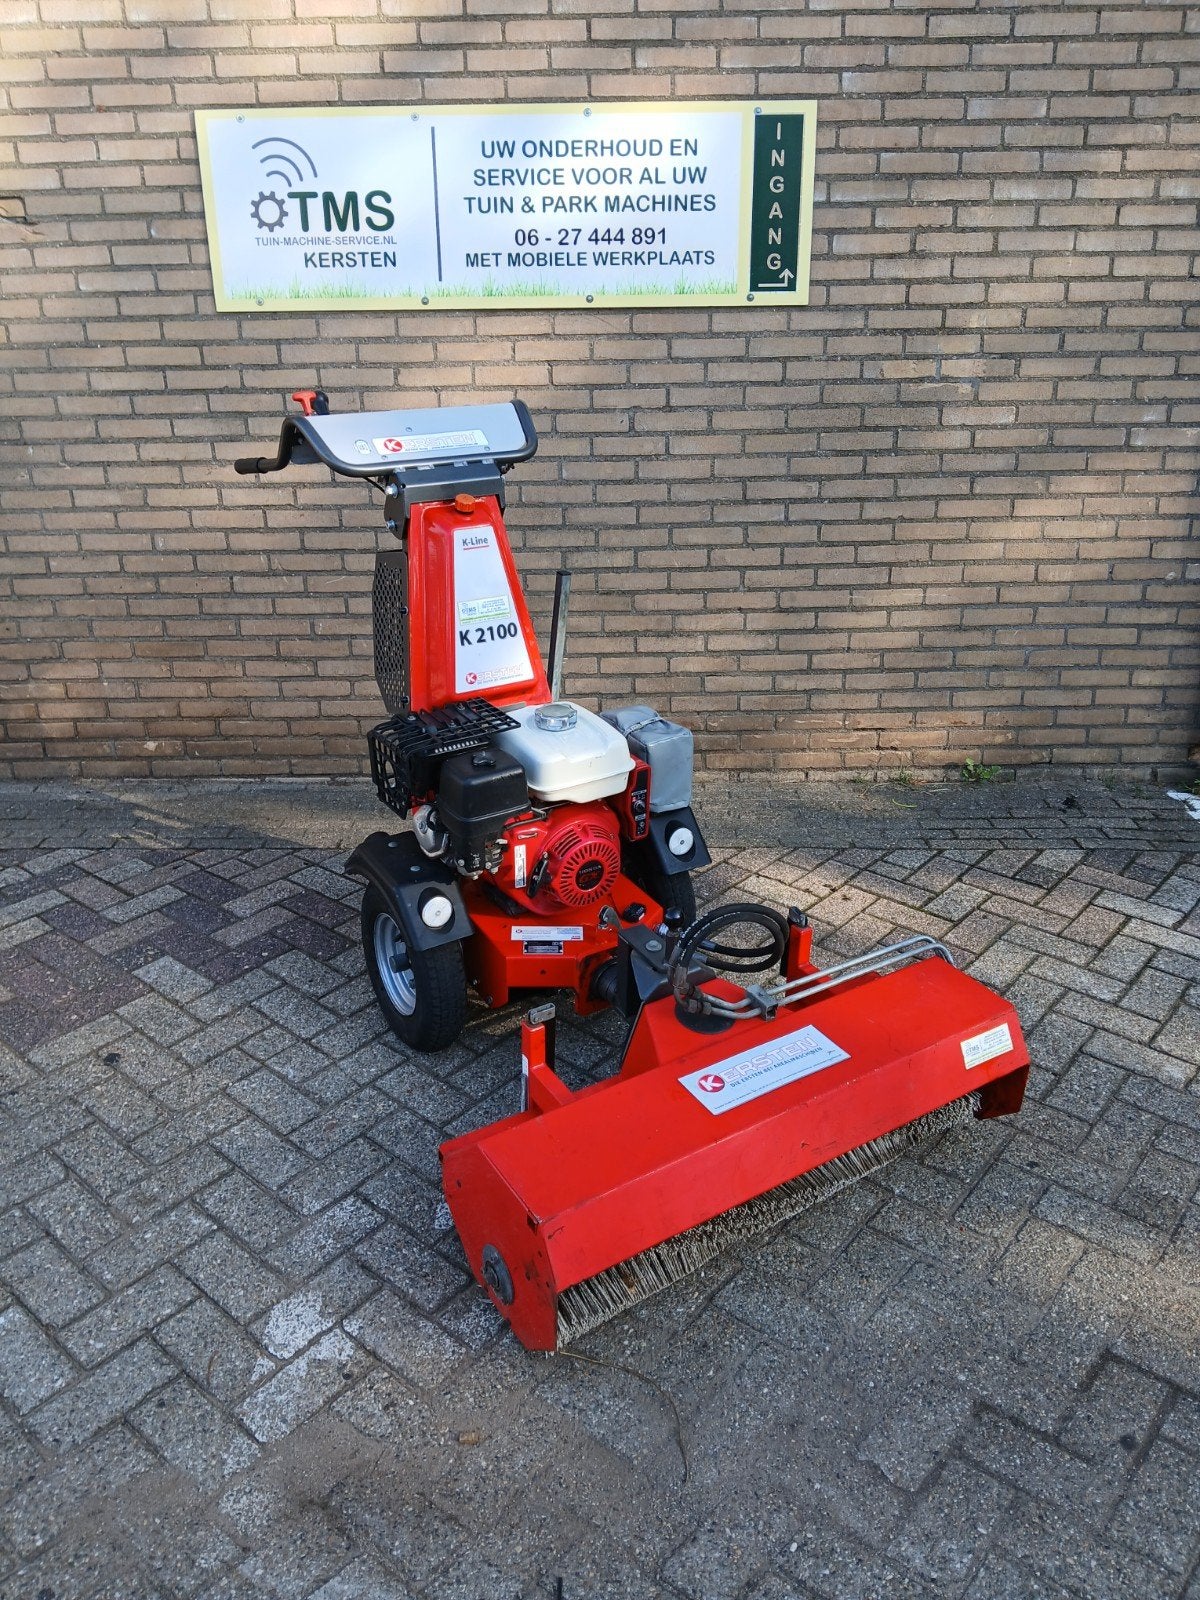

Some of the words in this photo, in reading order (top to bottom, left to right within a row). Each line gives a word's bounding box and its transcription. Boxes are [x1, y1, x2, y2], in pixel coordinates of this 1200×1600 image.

[481, 139, 516, 158] UW
[522, 138, 663, 158] ONDERHOUD
[670, 138, 698, 156] EN
[473, 167, 565, 186] SERVICE
[571, 167, 633, 185] VOOR
[639, 166, 666, 184] AL
[673, 166, 708, 184] UW
[463, 196, 514, 214] TUIN
[521, 195, 536, 213] &
[542, 195, 598, 213] PARK
[604, 194, 716, 212] MACHINES
[766, 122, 785, 270] INGANG
[287, 190, 394, 232] TMS
[255, 235, 397, 246] TUIN-MACHINE-SERVICE.NL
[515, 228, 539, 246] 06
[558, 228, 584, 246] 27
[587, 227, 625, 245] 444
[631, 227, 667, 245] 891
[304, 251, 397, 268] KERSTEN
[465, 252, 502, 268] MET
[507, 251, 587, 267] MOBIELE
[593, 250, 715, 266] WERKPLAATS
[384, 432, 477, 452] KERSTEN
[462, 536, 489, 547] K-Line
[459, 630, 472, 646] K
[476, 622, 518, 643] 2100
[698, 1037, 819, 1093] KERSTEN
